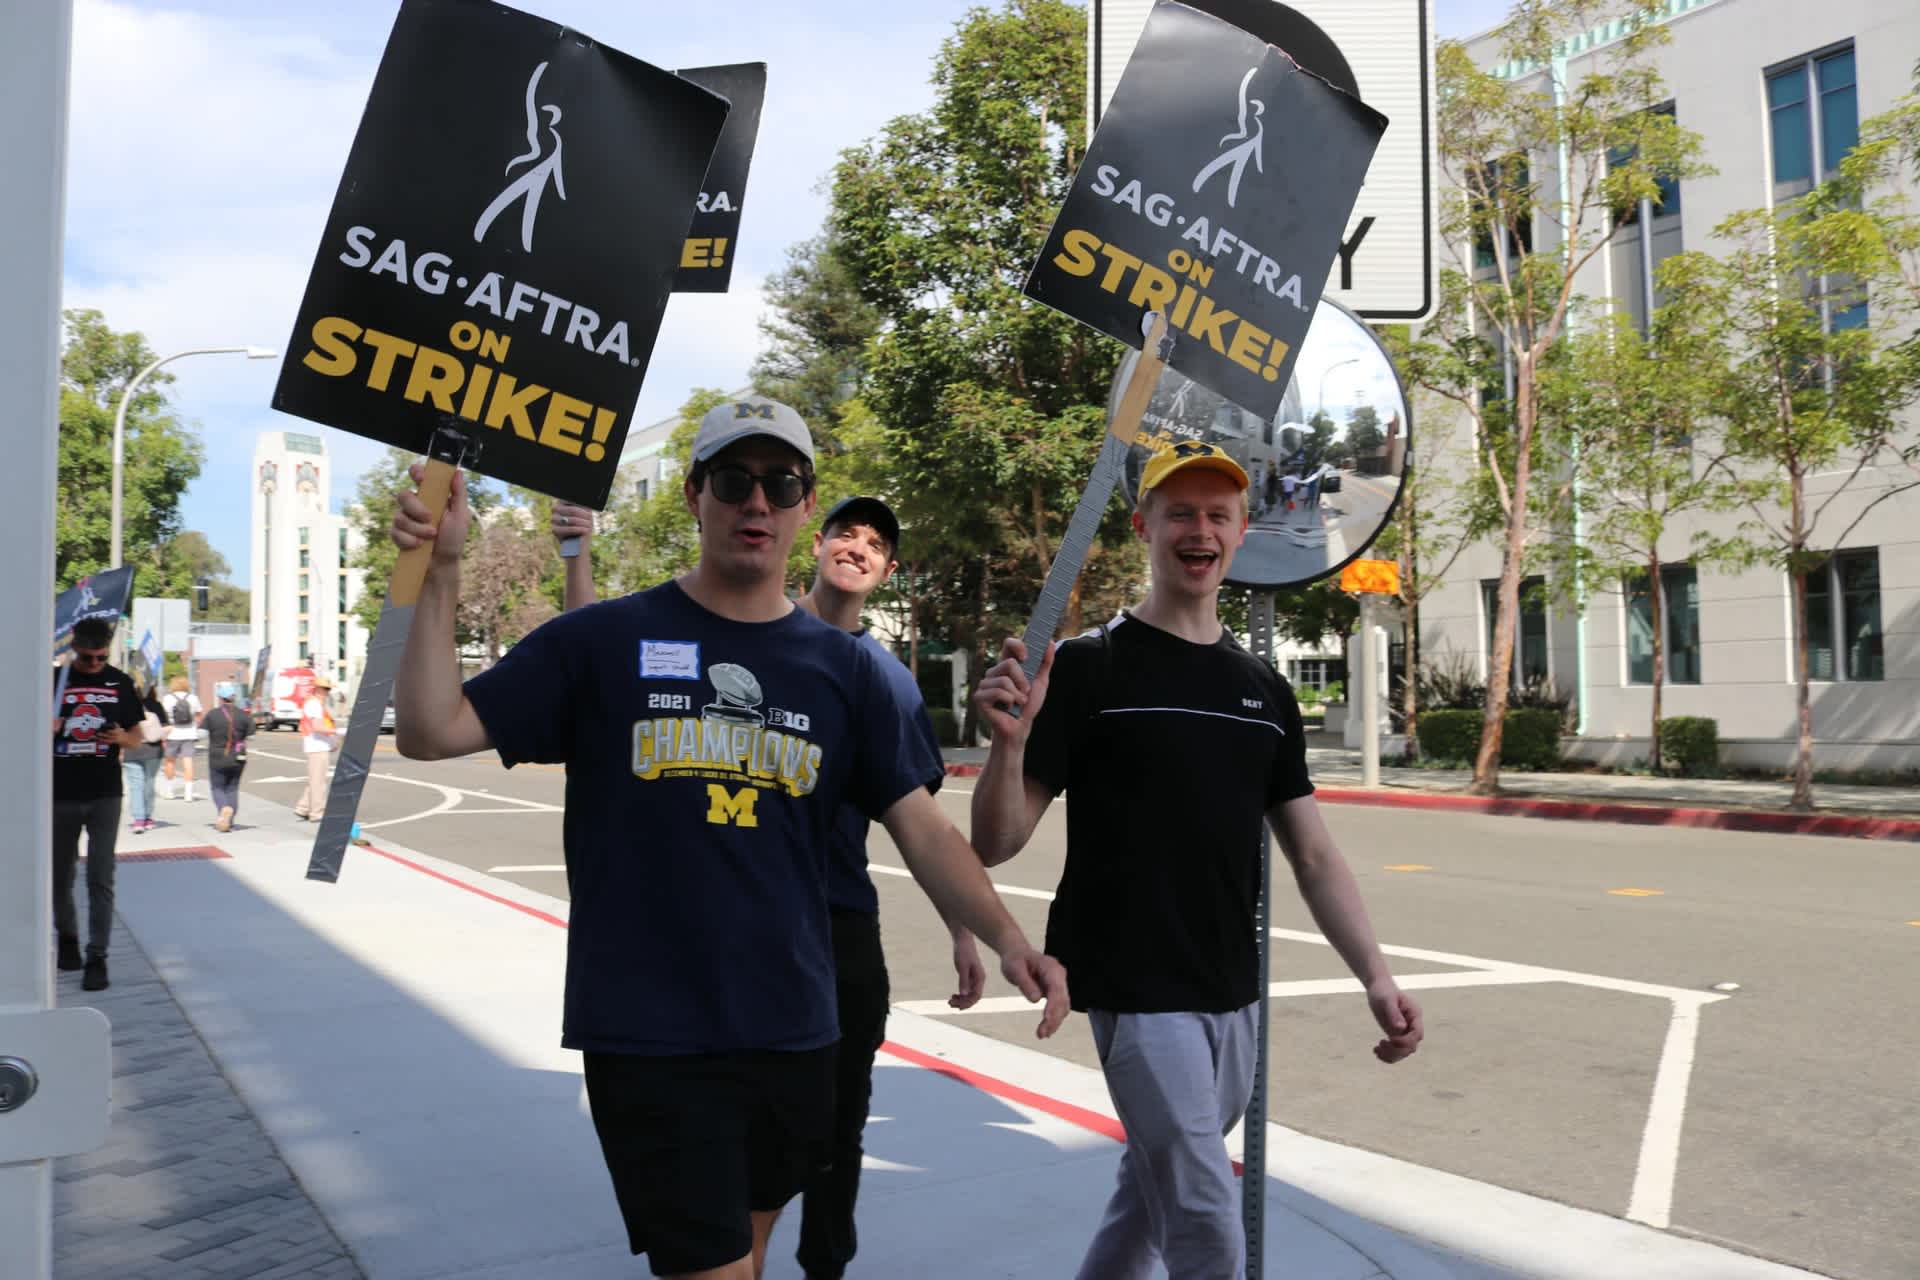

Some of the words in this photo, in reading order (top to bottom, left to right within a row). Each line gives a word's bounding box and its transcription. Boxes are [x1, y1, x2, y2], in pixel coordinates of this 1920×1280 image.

[1168, 248, 1215, 289] ON
[1053, 229, 1290, 383] STRIKE!
[449, 320, 511, 364] ON
[303, 316, 617, 463] STRIKE!
[735, 403, 775, 420] M
[648, 693, 691, 710] 2021
[632, 717, 823, 797] CHAMPIONS
[707, 783, 758, 827] M
